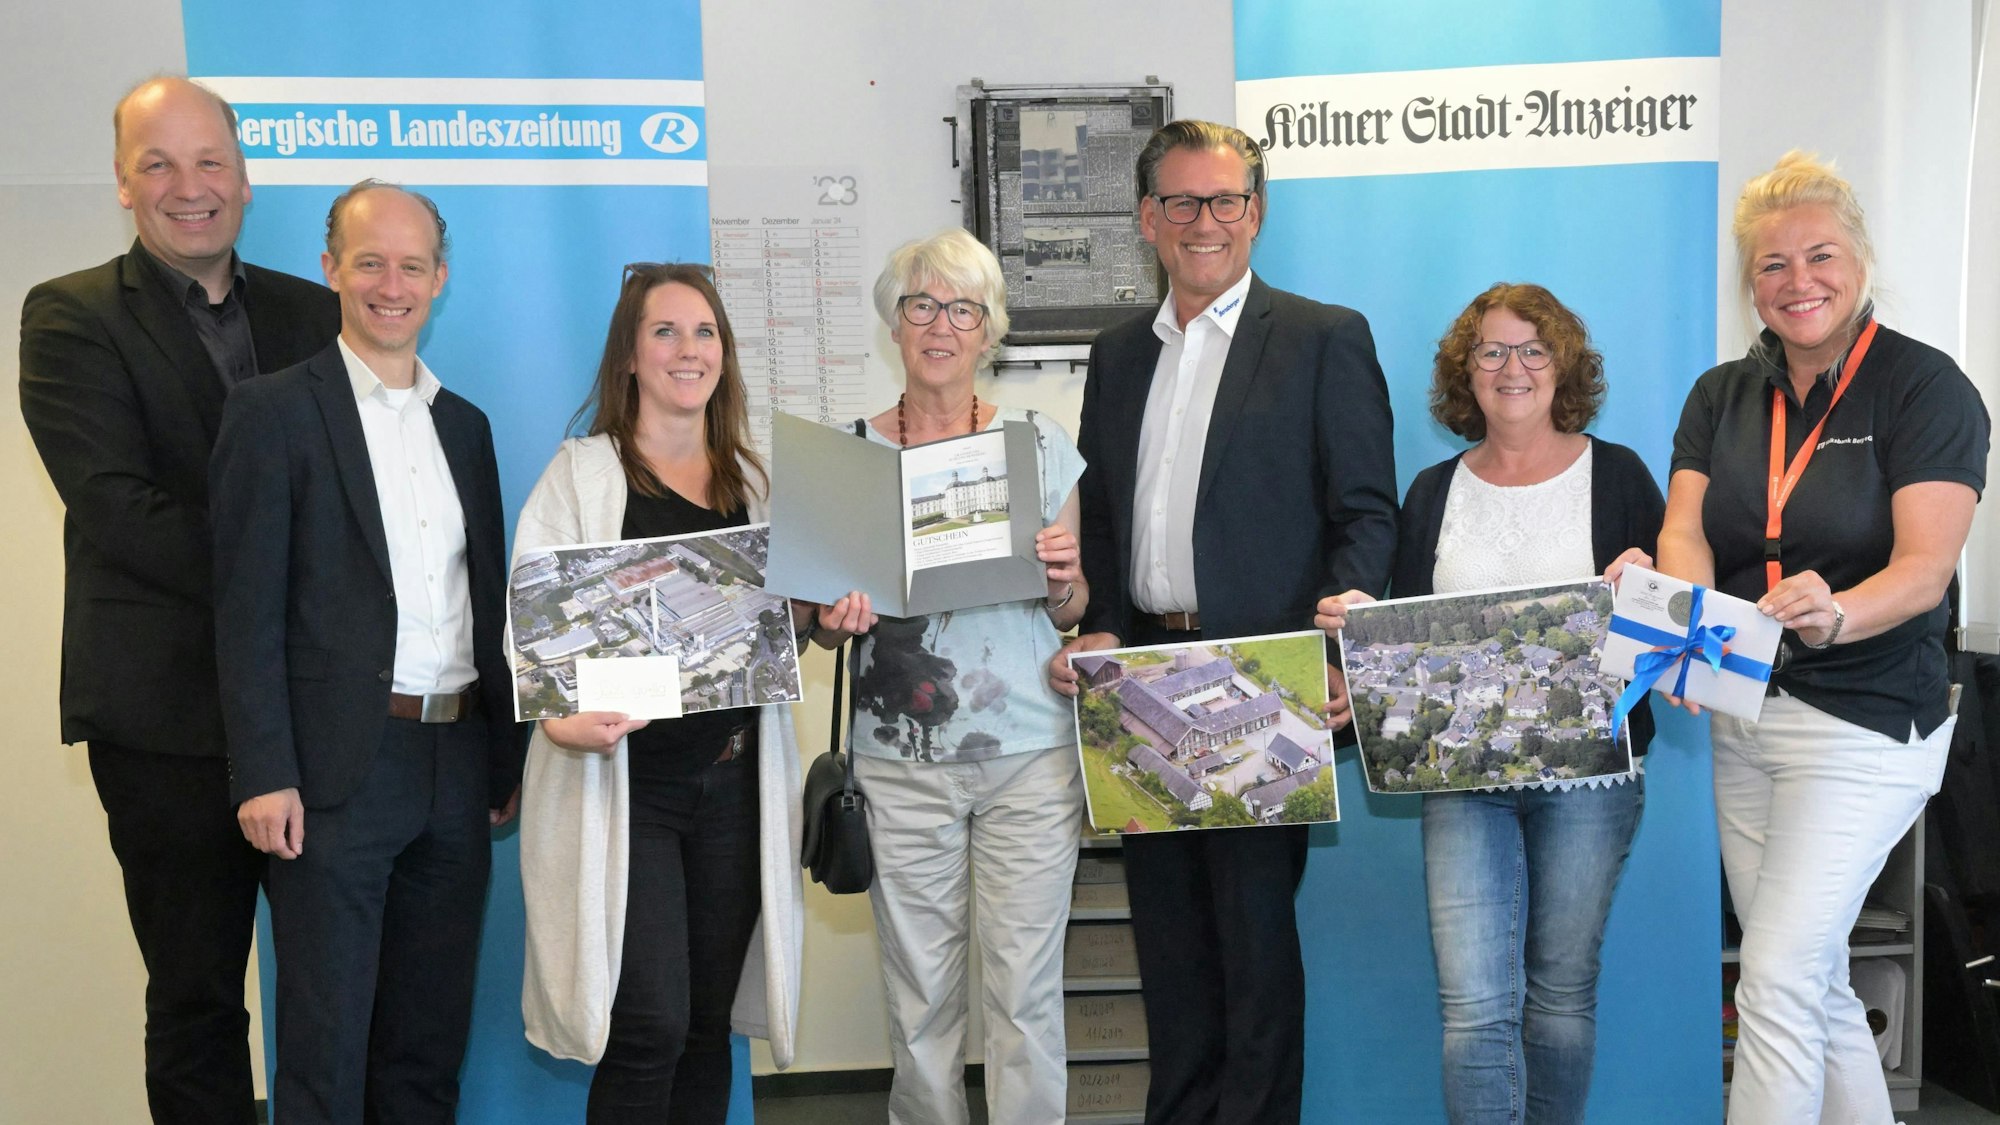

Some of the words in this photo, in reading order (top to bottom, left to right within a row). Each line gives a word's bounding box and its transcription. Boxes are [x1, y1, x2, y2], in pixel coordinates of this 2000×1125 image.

[1260, 100, 1393, 152] Kölner
[1402, 85, 1698, 144] Stadt-Anzeiger
[233, 109, 378, 155] ergische
[390, 110, 622, 156] Landeszeitung
[712, 217, 750, 225] November
[762, 217, 800, 225] Dezember
[811, 217, 832, 225] Januar
[714, 240, 721, 248] 2
[764, 239, 771, 248] 2
[814, 238, 821, 247] 2
[714, 250, 721, 258] 3
[814, 248, 821, 257] 3
[765, 259, 771, 267] 4
[815, 258, 821, 266] 4
[765, 269, 772, 278] 5
[815, 268, 821, 276] 5
[716, 280, 723, 288] 6
[766, 279, 772, 288] 6
[815, 278, 822, 287] 6
[766, 288, 772, 297] 7
[767, 298, 773, 307] 8
[816, 298, 822, 306] 8
[767, 308, 773, 316] 9
[816, 307, 823, 315] 9
[767, 318, 775, 326] 10
[816, 317, 824, 326] 10
[817, 327, 824, 335] 11
[768, 338, 776, 346] 12
[817, 337, 825, 345] 12
[768, 348, 777, 356] 13
[817, 346, 826, 354] 13
[769, 367, 778, 375] 15
[769, 377, 778, 385] 16
[769, 387, 777, 395] 17
[770, 397, 779, 405] 18
[819, 396, 828, 404] 18
[819, 415, 829, 423] 20
[912, 530, 969, 547] GUTSCHEIN
[1079, 1072, 1121, 1087] 02/2019
